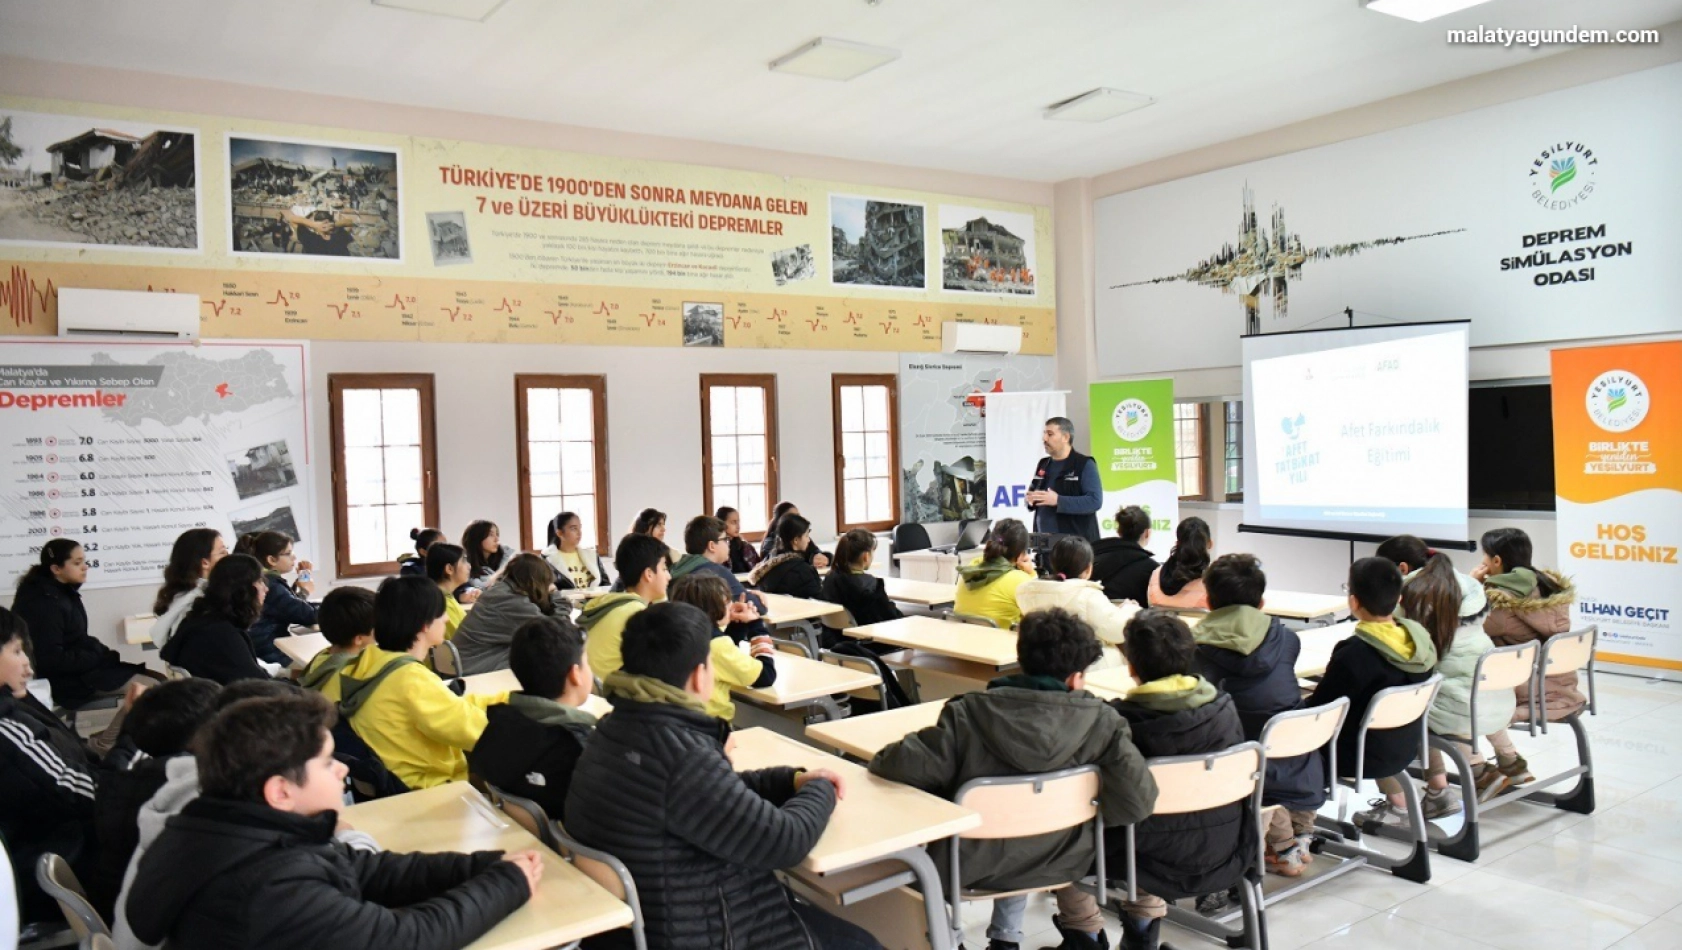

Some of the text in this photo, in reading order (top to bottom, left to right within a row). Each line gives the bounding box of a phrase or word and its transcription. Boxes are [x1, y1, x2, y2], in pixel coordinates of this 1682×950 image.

[439, 164, 808, 216] TÜRKİYE'DE 1900'DEN SONRA MEYDANA GELEN
[476, 196, 784, 236] 7 ve ÜZERİ BÜYÜKLÜKTEKİ DEPREMLER
[1522, 223, 1606, 248] DEPREM
[1500, 241, 1633, 271] SİMÜLASYON
[1534, 267, 1596, 286] ODASI
[230, 306, 242, 316] 7.2
[100, 377, 130, 388] Sebep
[133, 378, 154, 386] Olan
[0, 390, 127, 412] Depremler
[1341, 418, 1442, 439] Afet Farkındalık
[78, 436, 94, 446] 7.0
[1286, 440, 1308, 458] AFET
[78, 454, 94, 462] 6.8
[1368, 447, 1411, 466] Eğitimi
[80, 472, 96, 480] 6.0
[81, 488, 96, 497] 5.8
[992, 483, 1027, 508] AF
[82, 508, 97, 517] 5.8
[82, 524, 98, 534] 5.4
[84, 542, 98, 552] 5.2
[1570, 542, 1678, 564] GELDİNİZ
[1580, 602, 1670, 622] İLHAN GEÇİT
